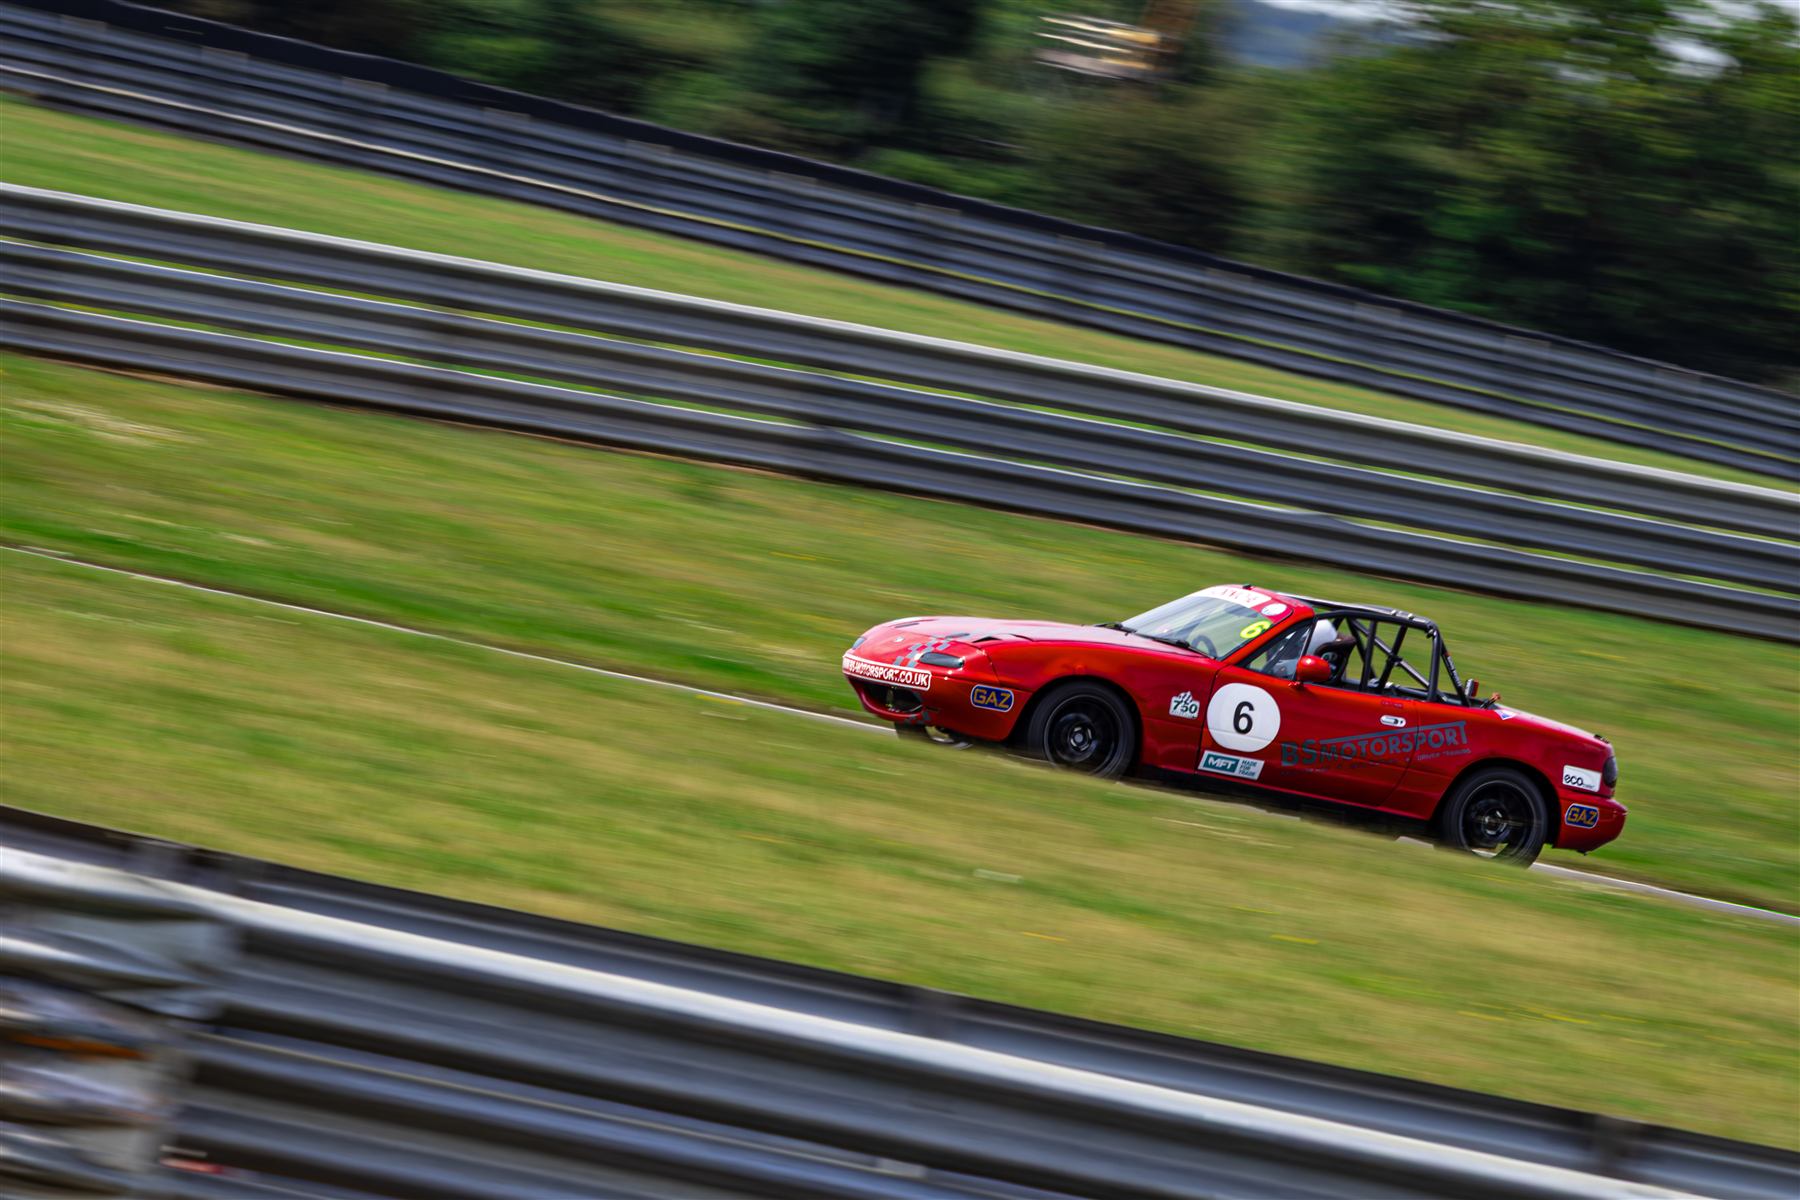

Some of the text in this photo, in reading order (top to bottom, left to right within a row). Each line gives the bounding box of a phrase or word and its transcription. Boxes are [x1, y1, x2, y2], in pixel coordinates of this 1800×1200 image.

[1240, 620, 1271, 639] 6
[973, 688, 1011, 709] GAZ
[1173, 700, 1198, 714] 750
[1233, 701, 1255, 735] 6
[1207, 756, 1236, 770] MFT
[1567, 807, 1597, 825] GAZ
